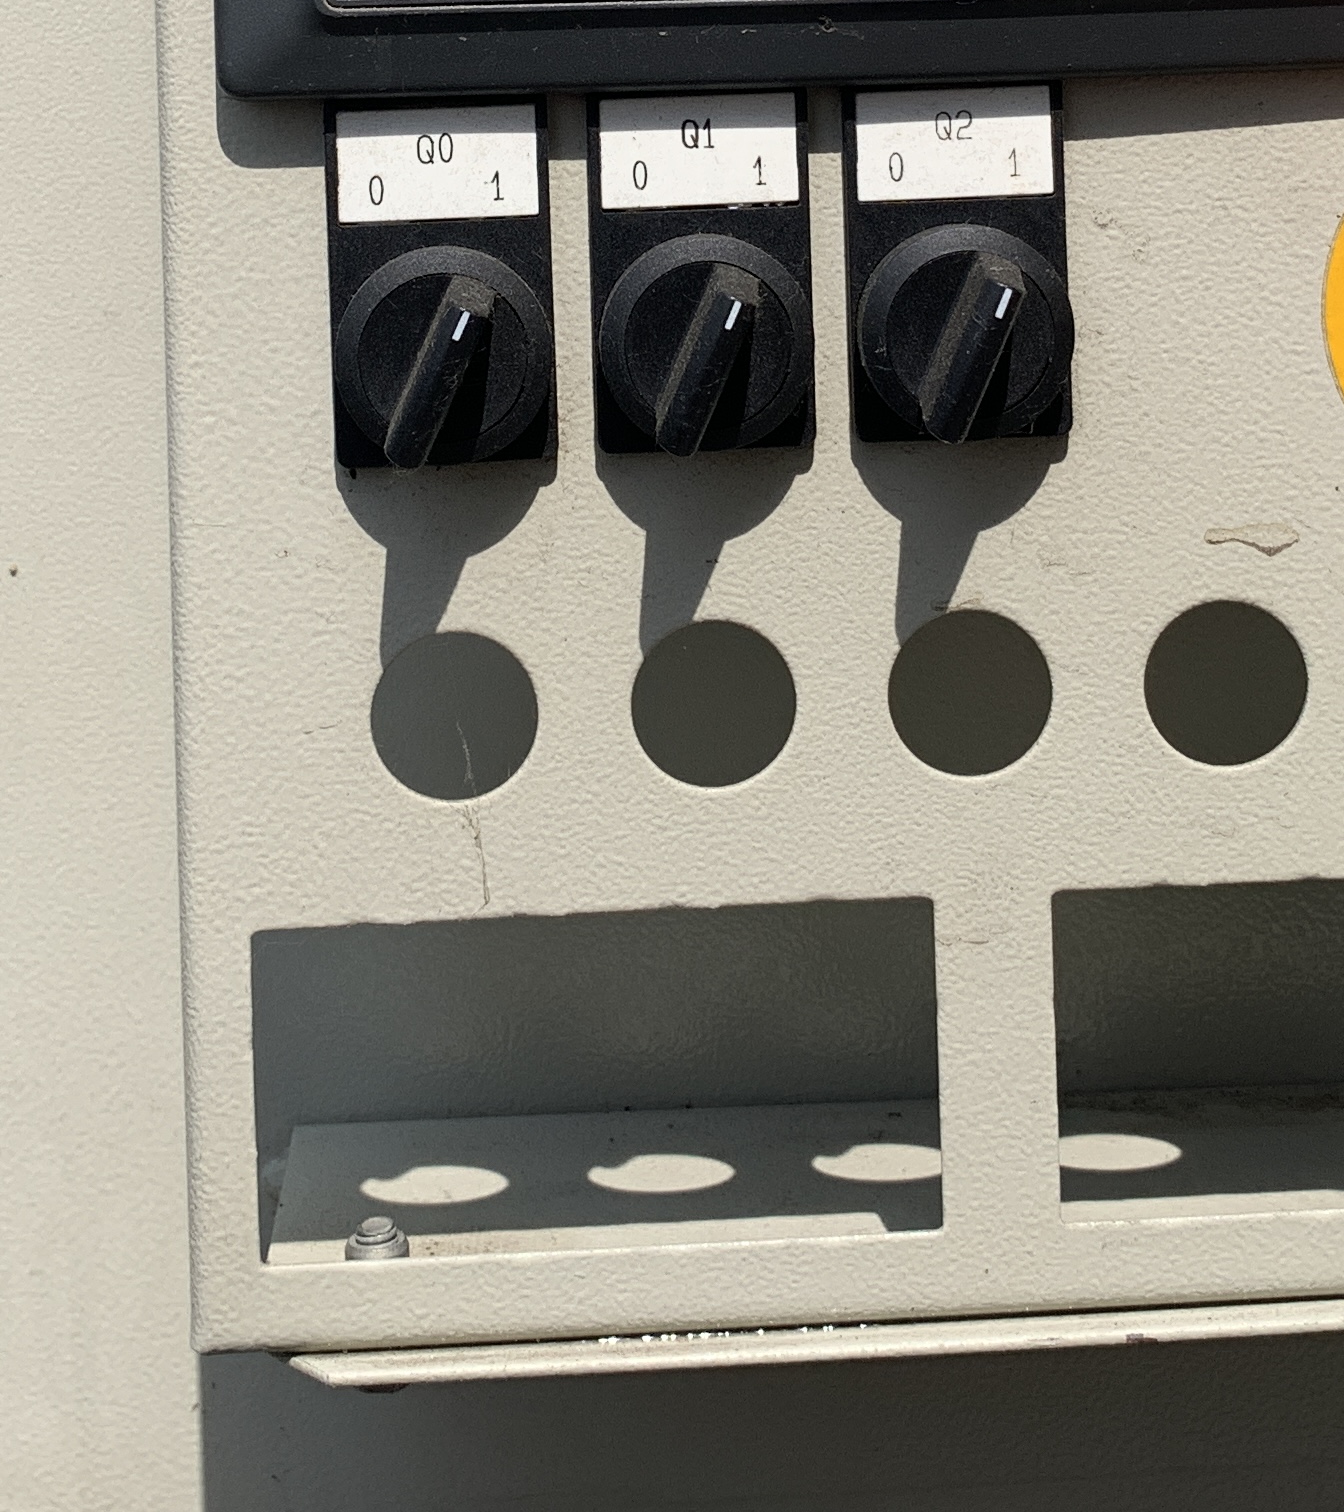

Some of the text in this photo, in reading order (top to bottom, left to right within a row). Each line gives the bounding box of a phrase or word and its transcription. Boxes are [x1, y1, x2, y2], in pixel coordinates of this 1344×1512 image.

[680, 119, 716, 149] Q1
[934, 111, 973, 141] Q2
[753, 157, 767, 186] 1
[1009, 149, 1022, 178] 1
[490, 172, 505, 201] 1
